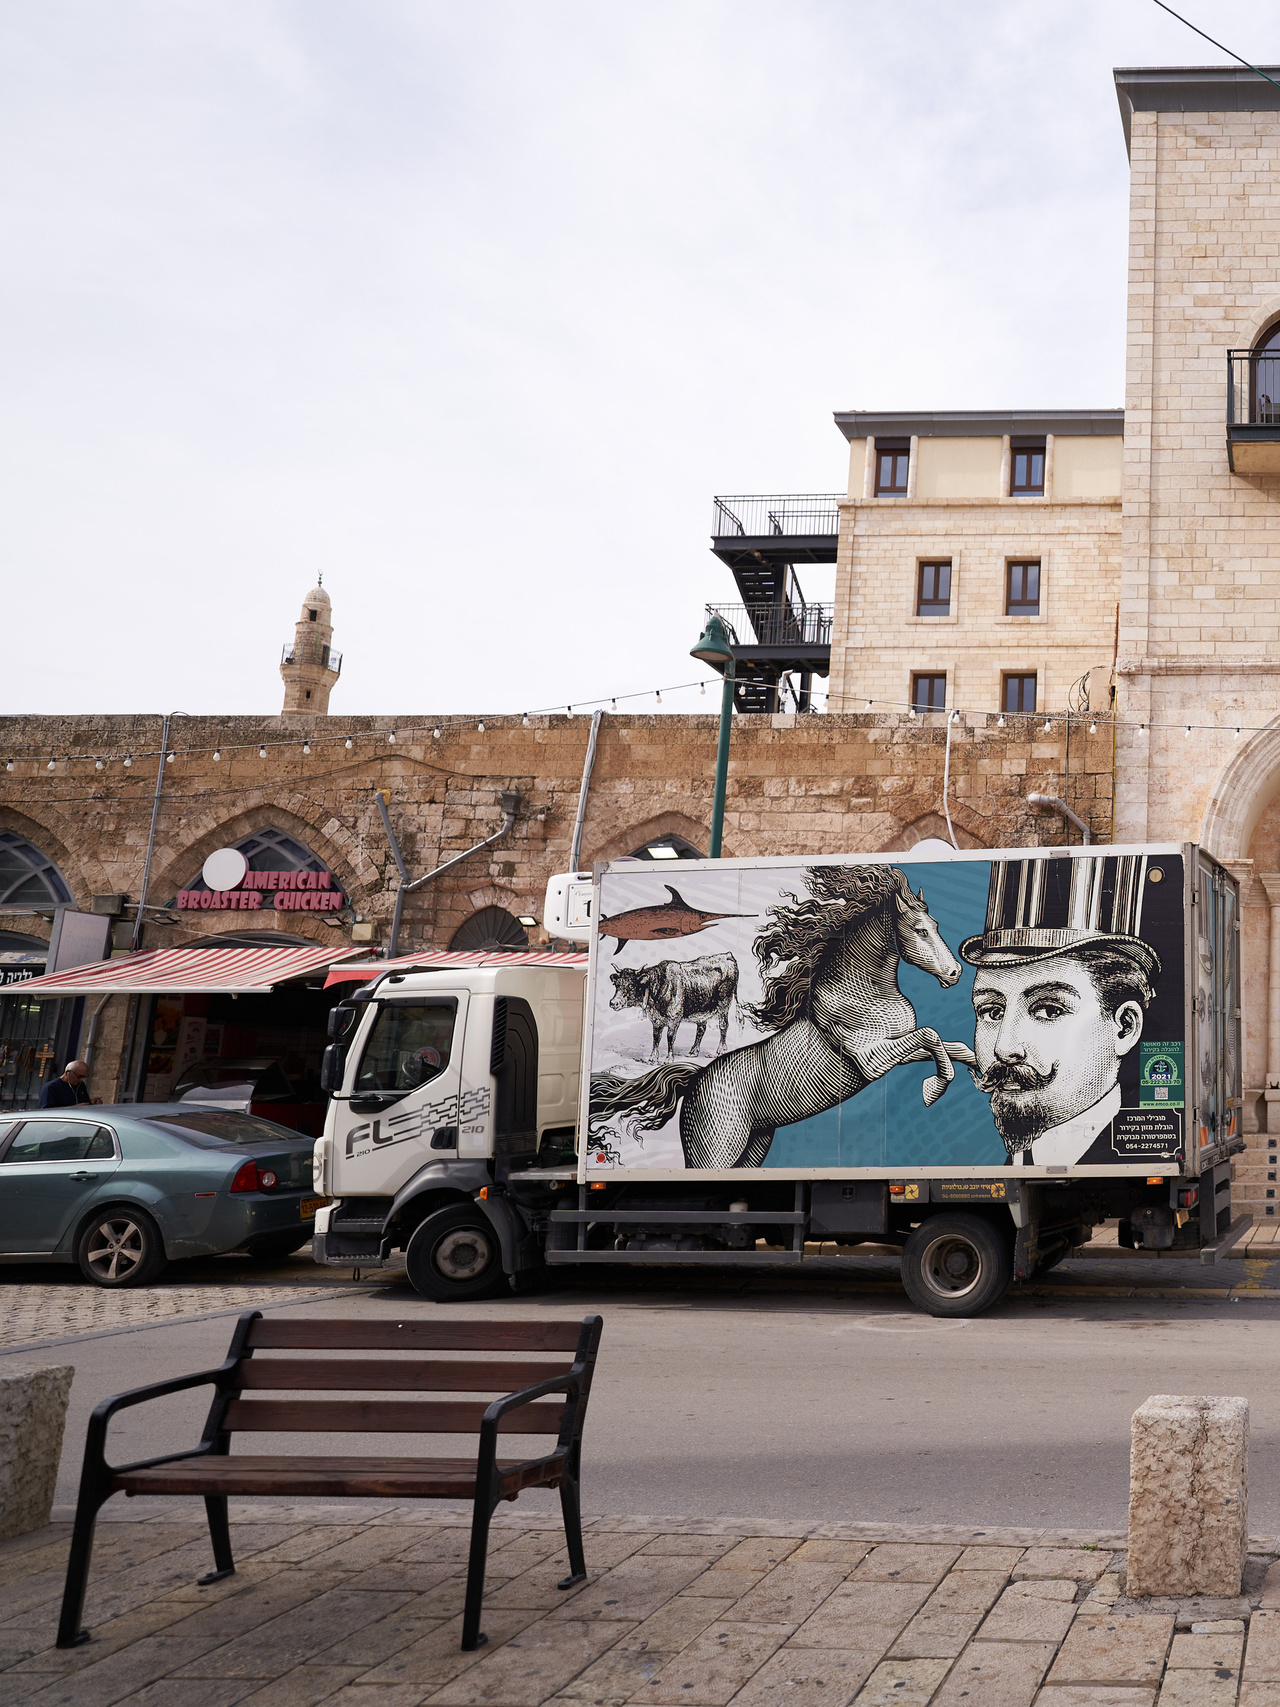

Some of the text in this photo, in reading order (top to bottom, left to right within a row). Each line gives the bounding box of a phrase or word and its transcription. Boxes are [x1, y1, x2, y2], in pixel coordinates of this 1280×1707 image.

[242, 871, 332, 890] AMERICAN
[176, 890, 344, 911] BROASTER CHICKEN
[461, 1125, 485, 1134] 210
[1154, 1123, 1174, 1131] הובלת
[346, 1119, 393, 1155] FL
[356, 1149, 371, 1157] 210
